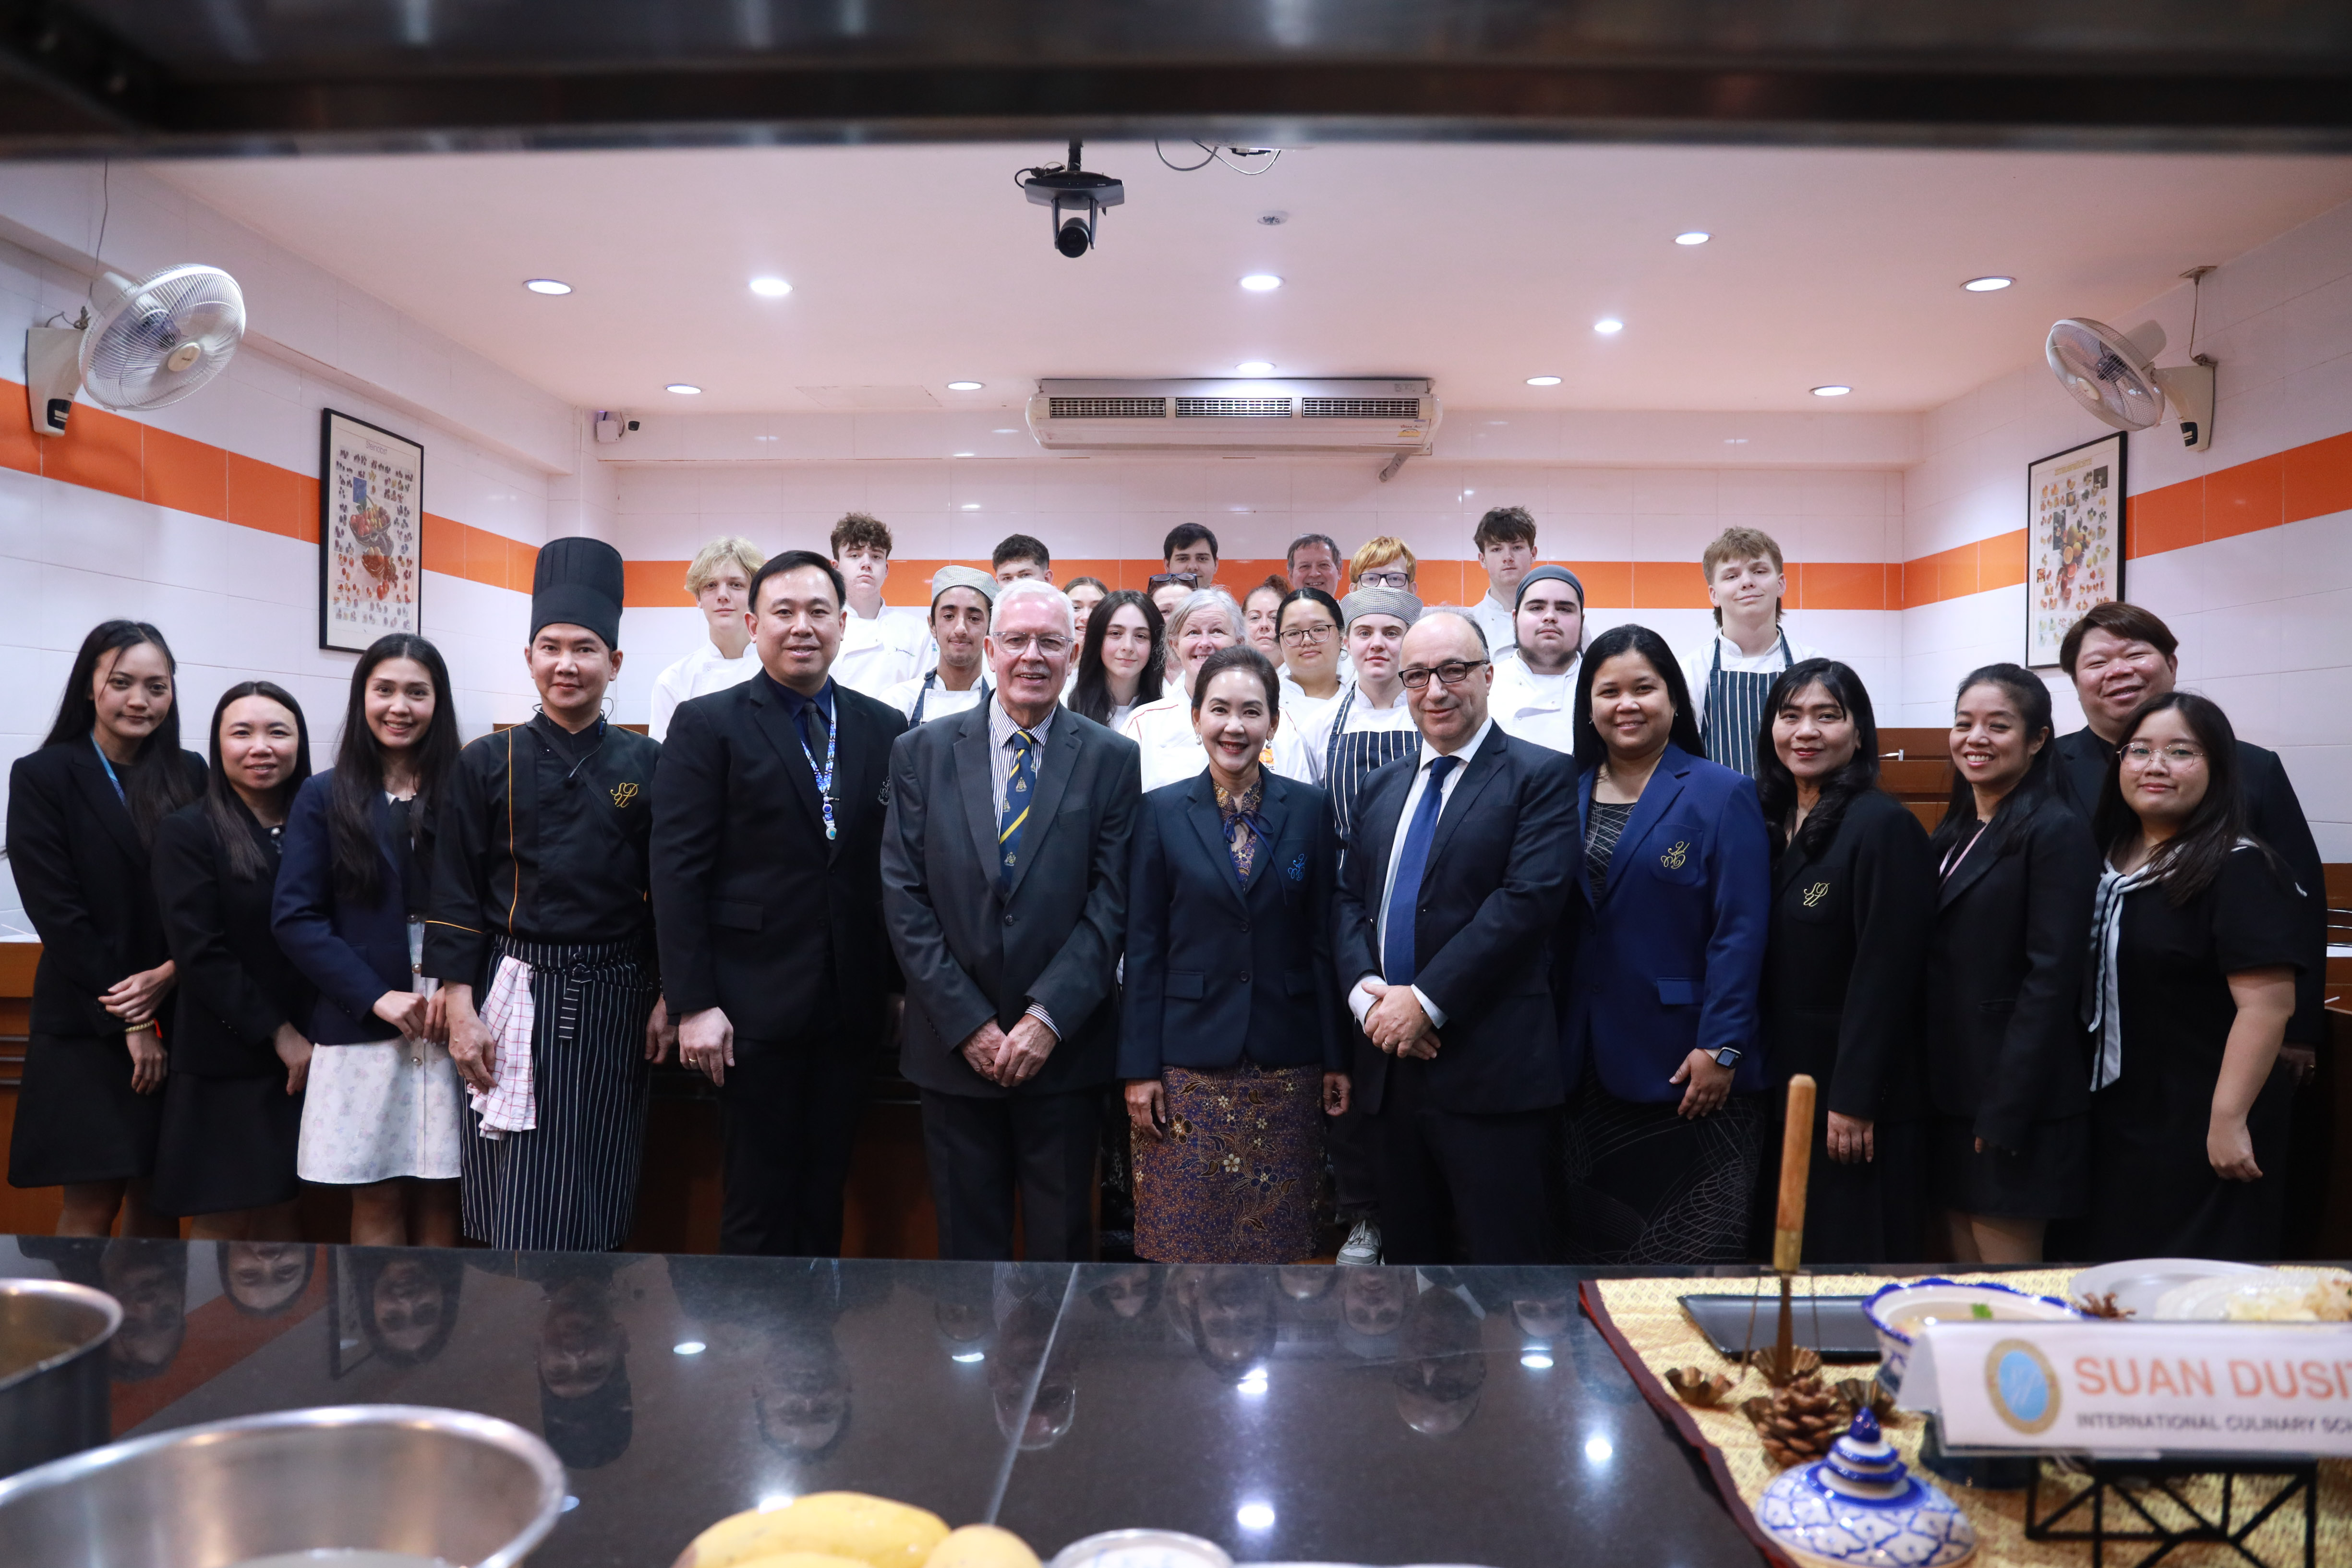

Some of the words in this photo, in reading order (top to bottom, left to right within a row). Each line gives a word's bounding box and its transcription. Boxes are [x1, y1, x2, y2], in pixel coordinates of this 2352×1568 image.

[365, 440, 388, 455] Steinobst
[2074, 1356, 2216, 1397] SUAN
[2227, 1359, 2352, 1400] DUSI
[2076, 1411, 2220, 1432] INTERNATIONAL
[2226, 1414, 2316, 1434] CULINARY
